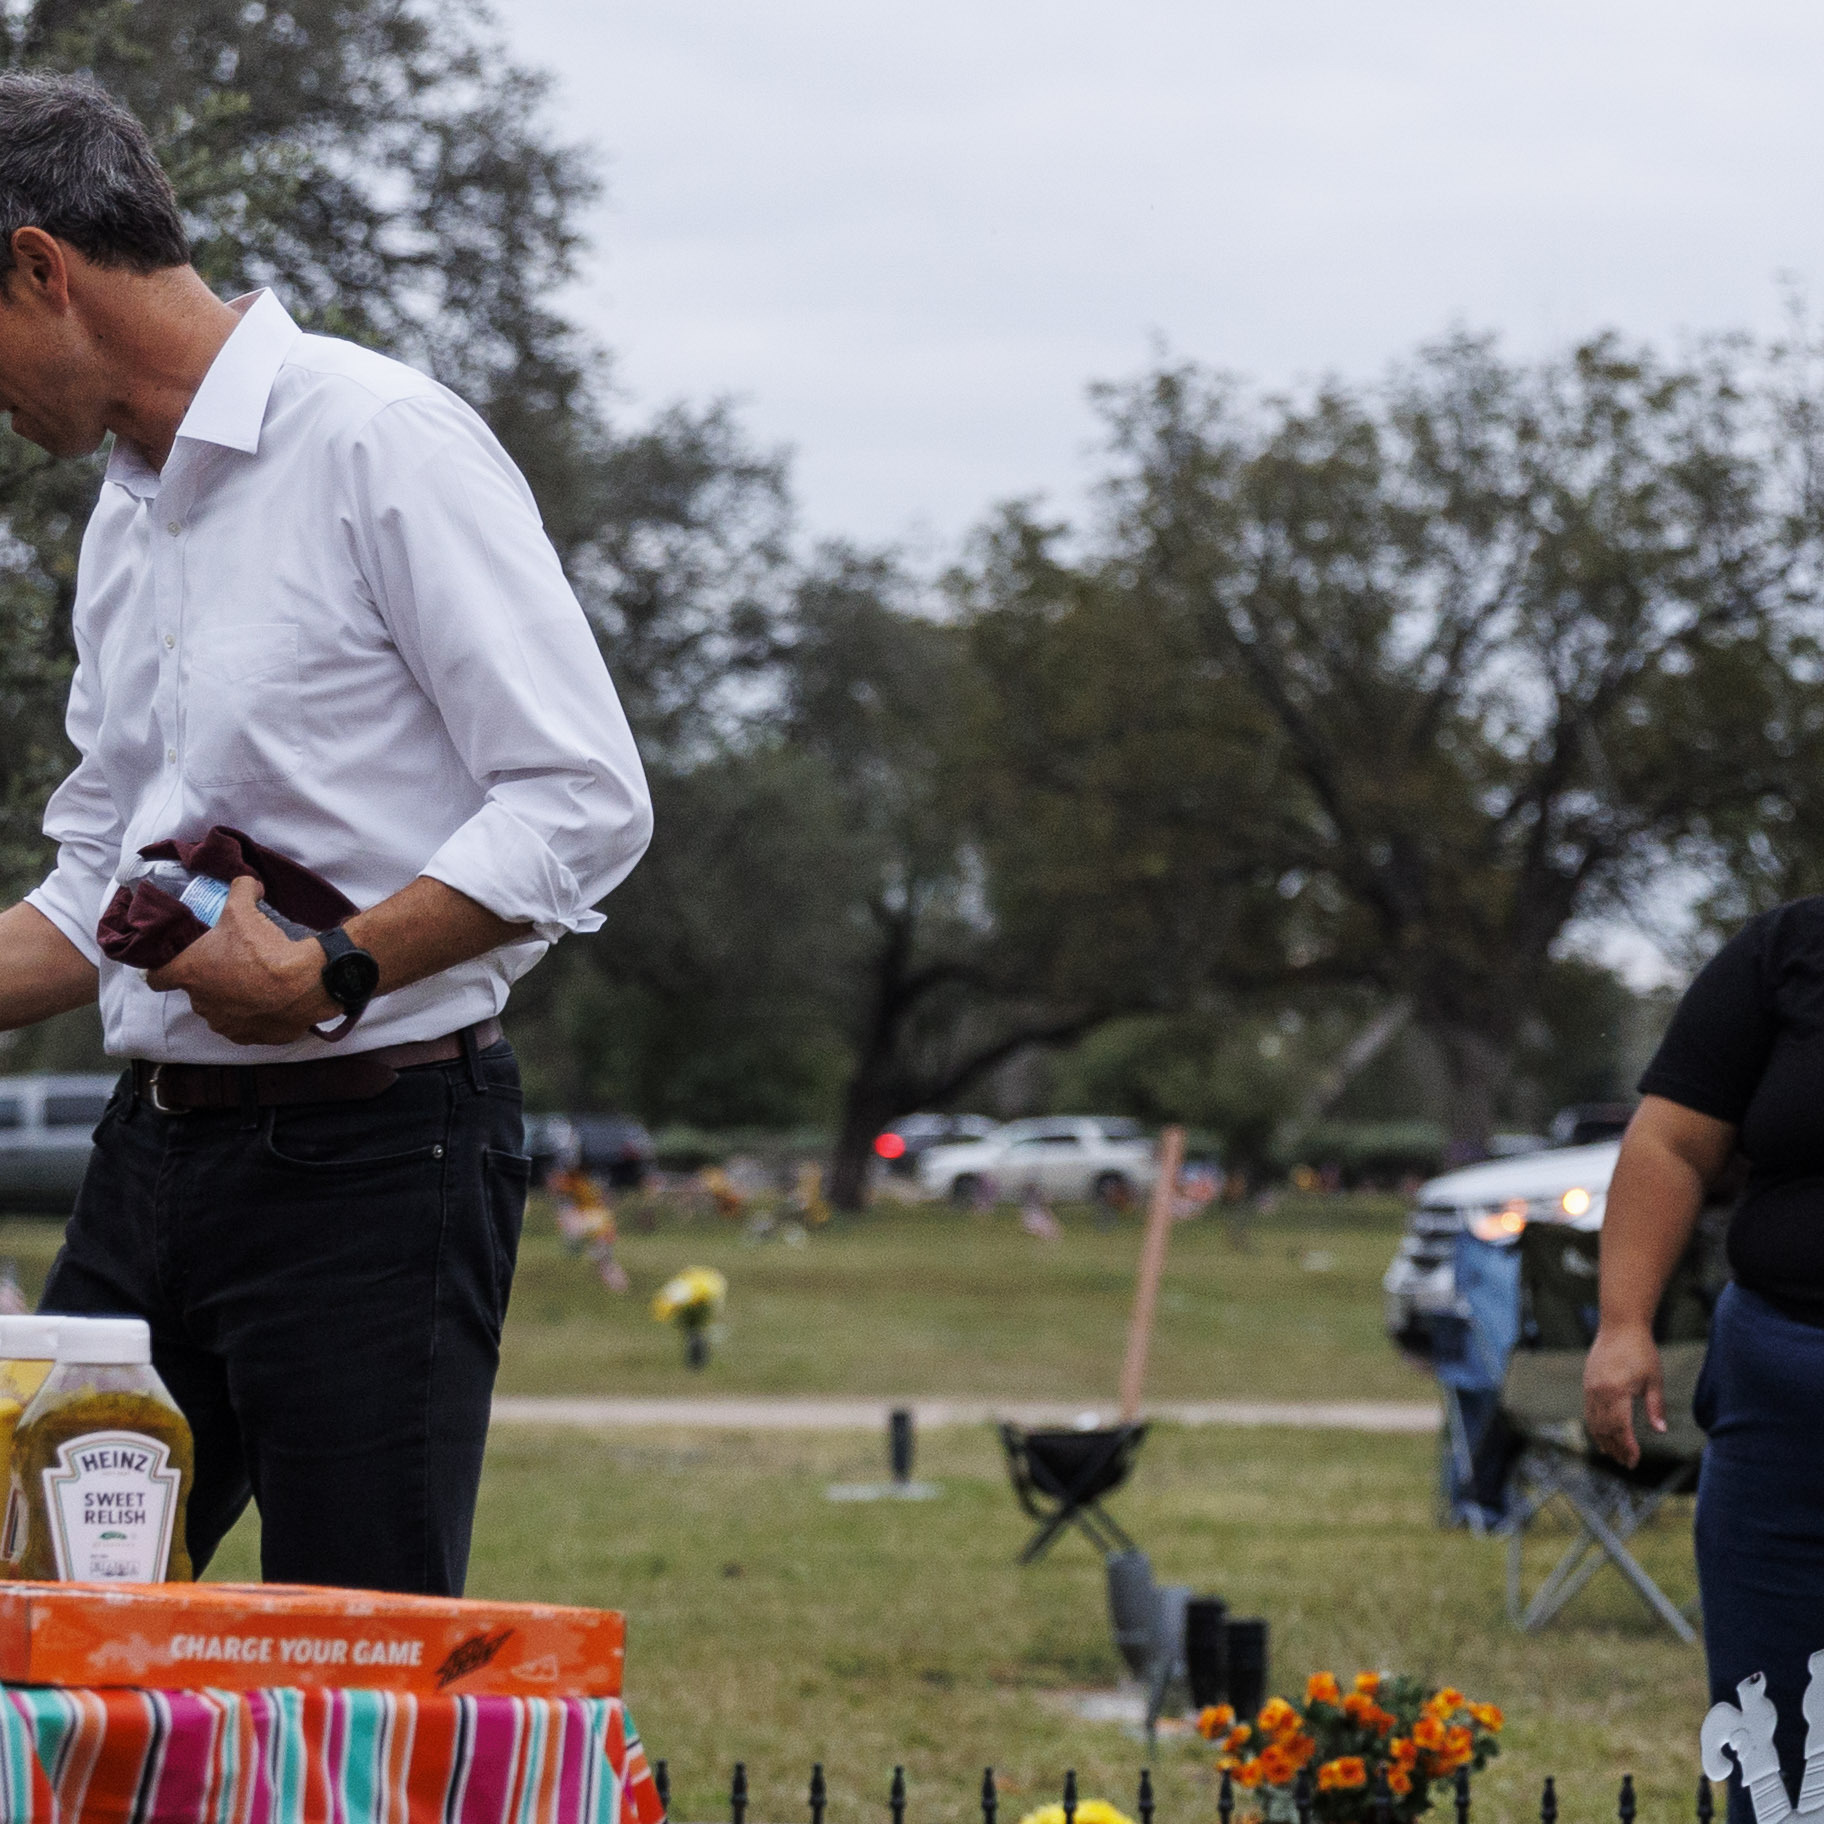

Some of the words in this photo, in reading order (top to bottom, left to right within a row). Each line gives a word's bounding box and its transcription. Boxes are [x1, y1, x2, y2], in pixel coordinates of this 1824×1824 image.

[81, 1450, 149, 1472] HEINZ
[84, 1492, 146, 1507] SWEET
[84, 1510, 146, 1525] RELISH
[170, 1633, 272, 1663] CHARGE
[278, 1637, 348, 1664] YOUR
[352, 1640, 425, 1667] GAME
